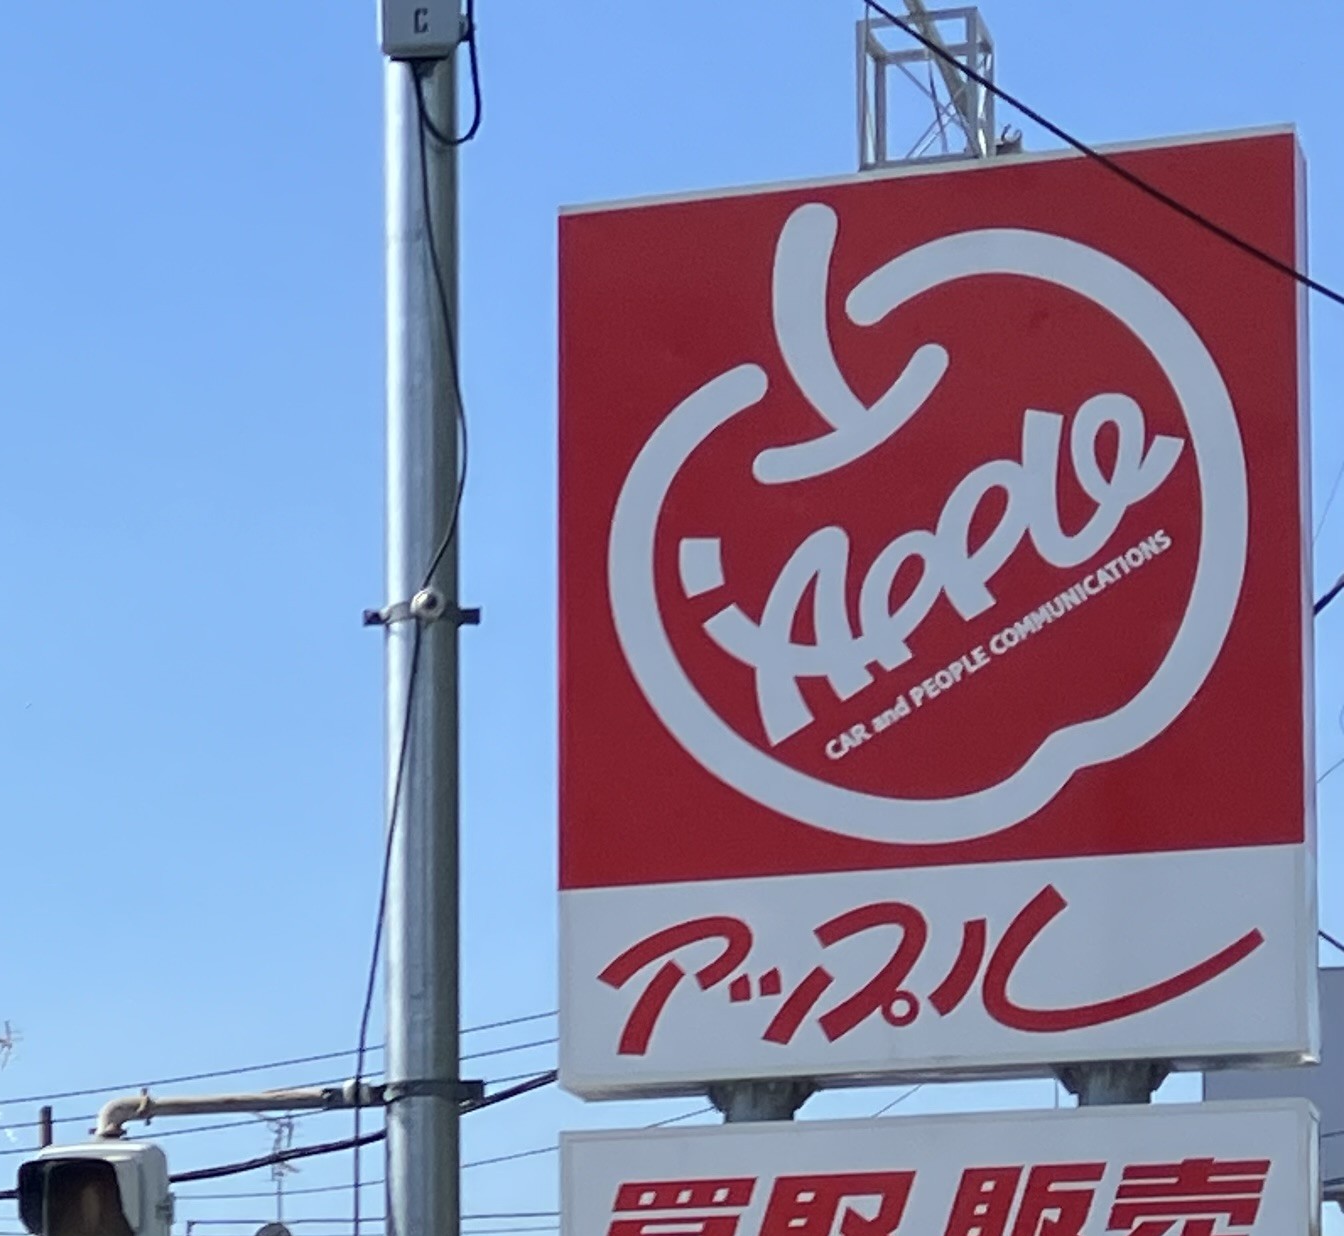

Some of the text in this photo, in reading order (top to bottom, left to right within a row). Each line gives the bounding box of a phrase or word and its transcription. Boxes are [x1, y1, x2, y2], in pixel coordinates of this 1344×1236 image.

[825, 528, 1173, 761] CAR and PEOPLE COMMUNICATIONS
[596, 883, 1266, 1056] アップル
